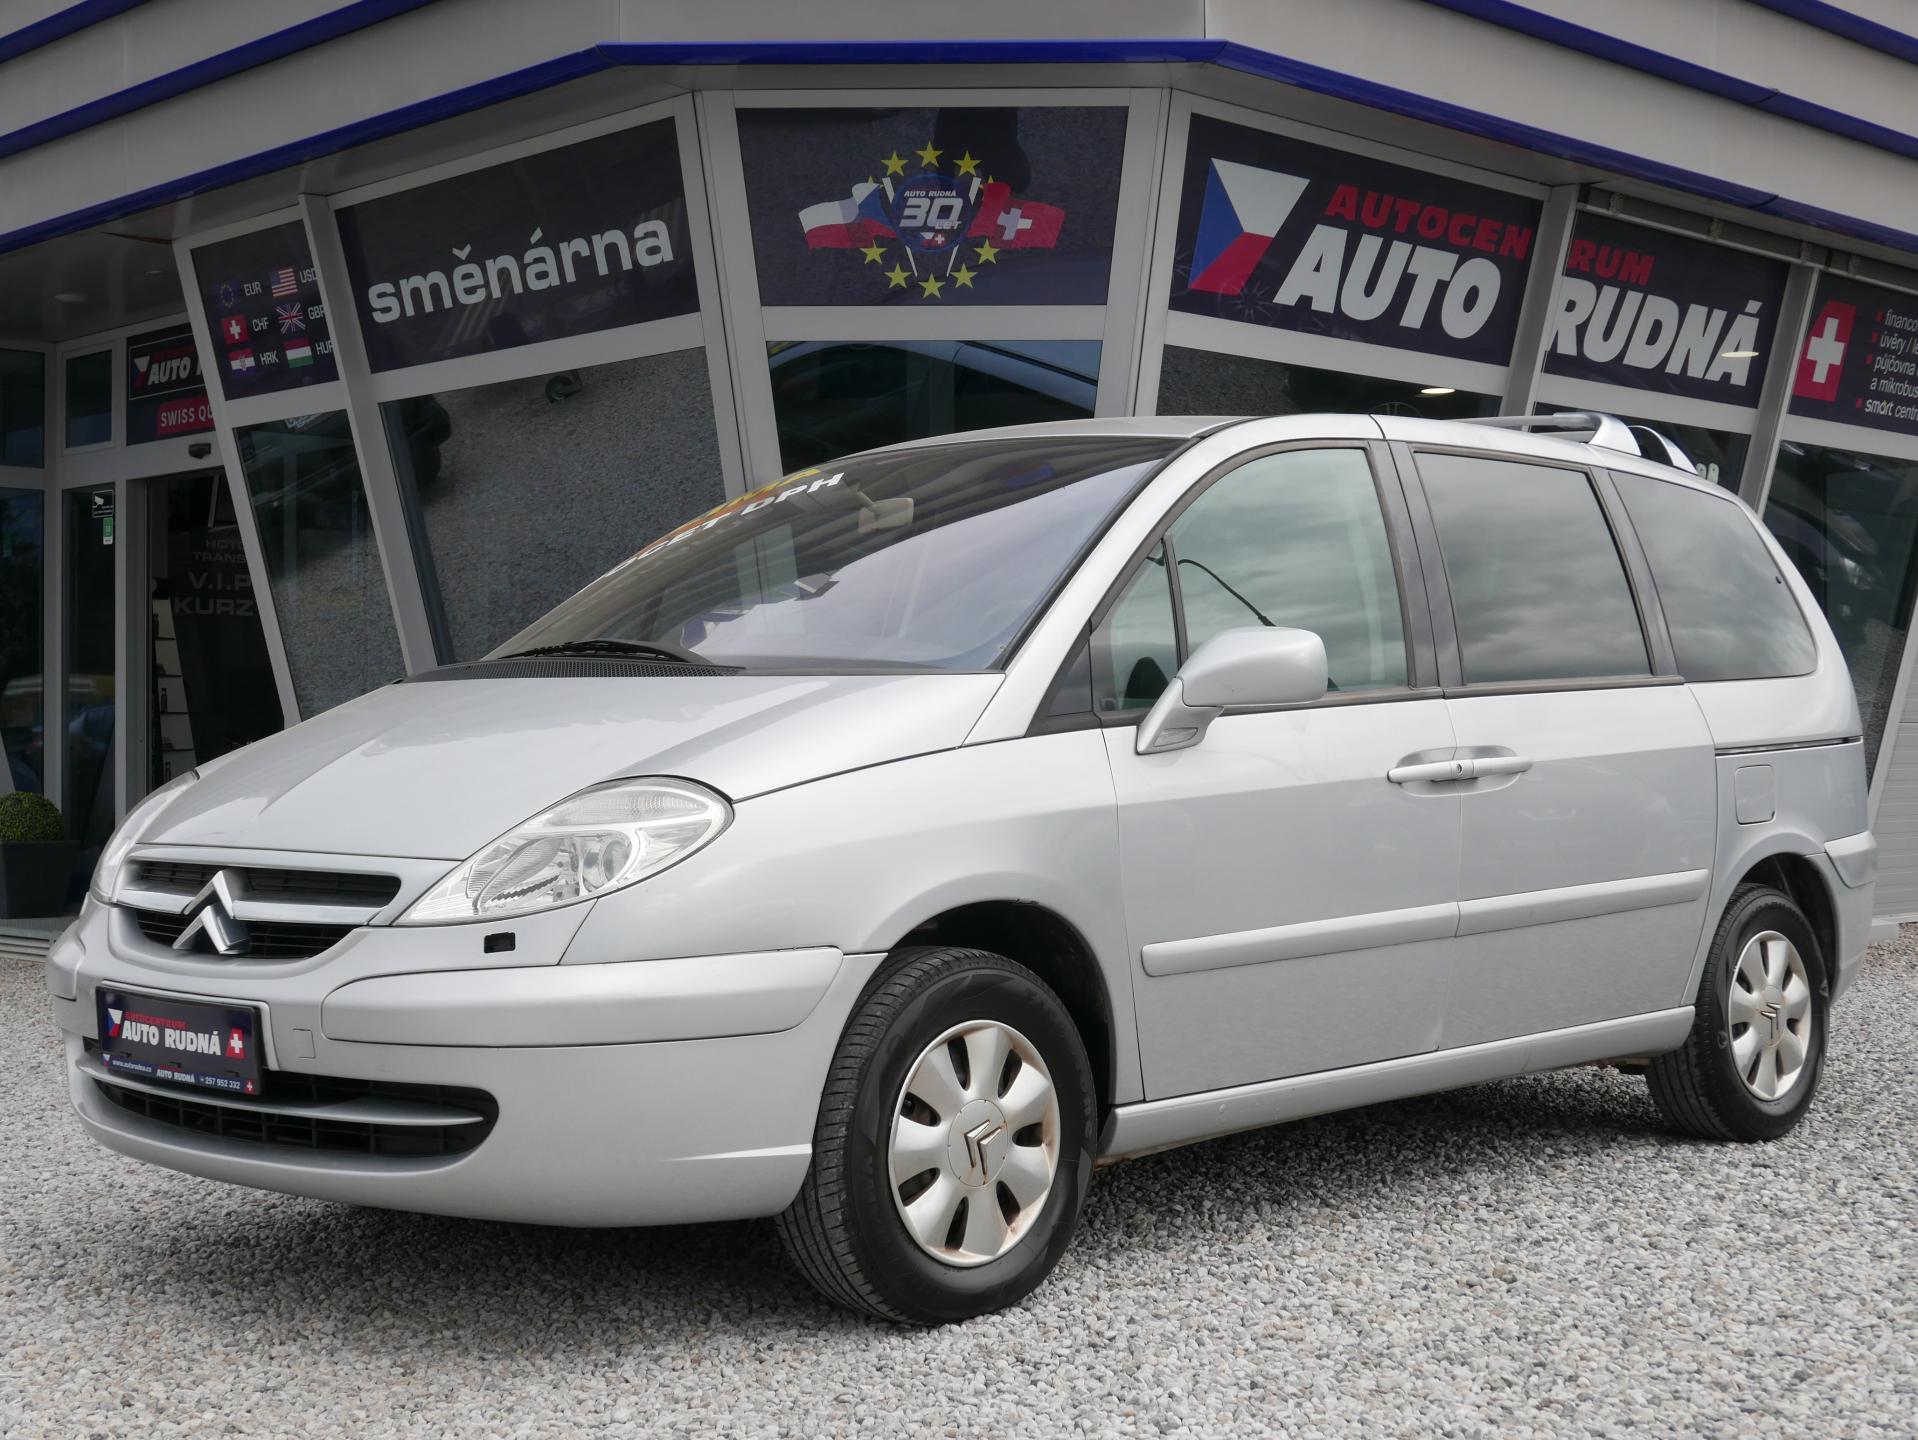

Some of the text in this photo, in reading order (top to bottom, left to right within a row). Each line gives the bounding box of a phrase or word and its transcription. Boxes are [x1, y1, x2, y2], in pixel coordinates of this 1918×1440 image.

[899, 197, 964, 227] 30
[243, 267, 318, 296] EUR USD
[368, 219, 674, 323] směnárna
[1272, 223, 1763, 387] AUTO RUDNÁ
[252, 317, 269, 332] CHF
[147, 356, 192, 386] AUTO
[259, 351, 279, 366] HRK
[1870, 377, 1877, 391] a
[160, 407, 195, 427] SWISS
[1864, 398, 1893, 416] smart
[740, 472, 845, 515] DPH
[174, 596, 254, 617] KURZ
[121, 1020, 222, 1056] AUTO RUDNÁ
[156, 1068, 172, 1079] AUTO
[173, 1070, 195, 1083] RUDNÁ
[216, 1077, 228, 1088] 952
